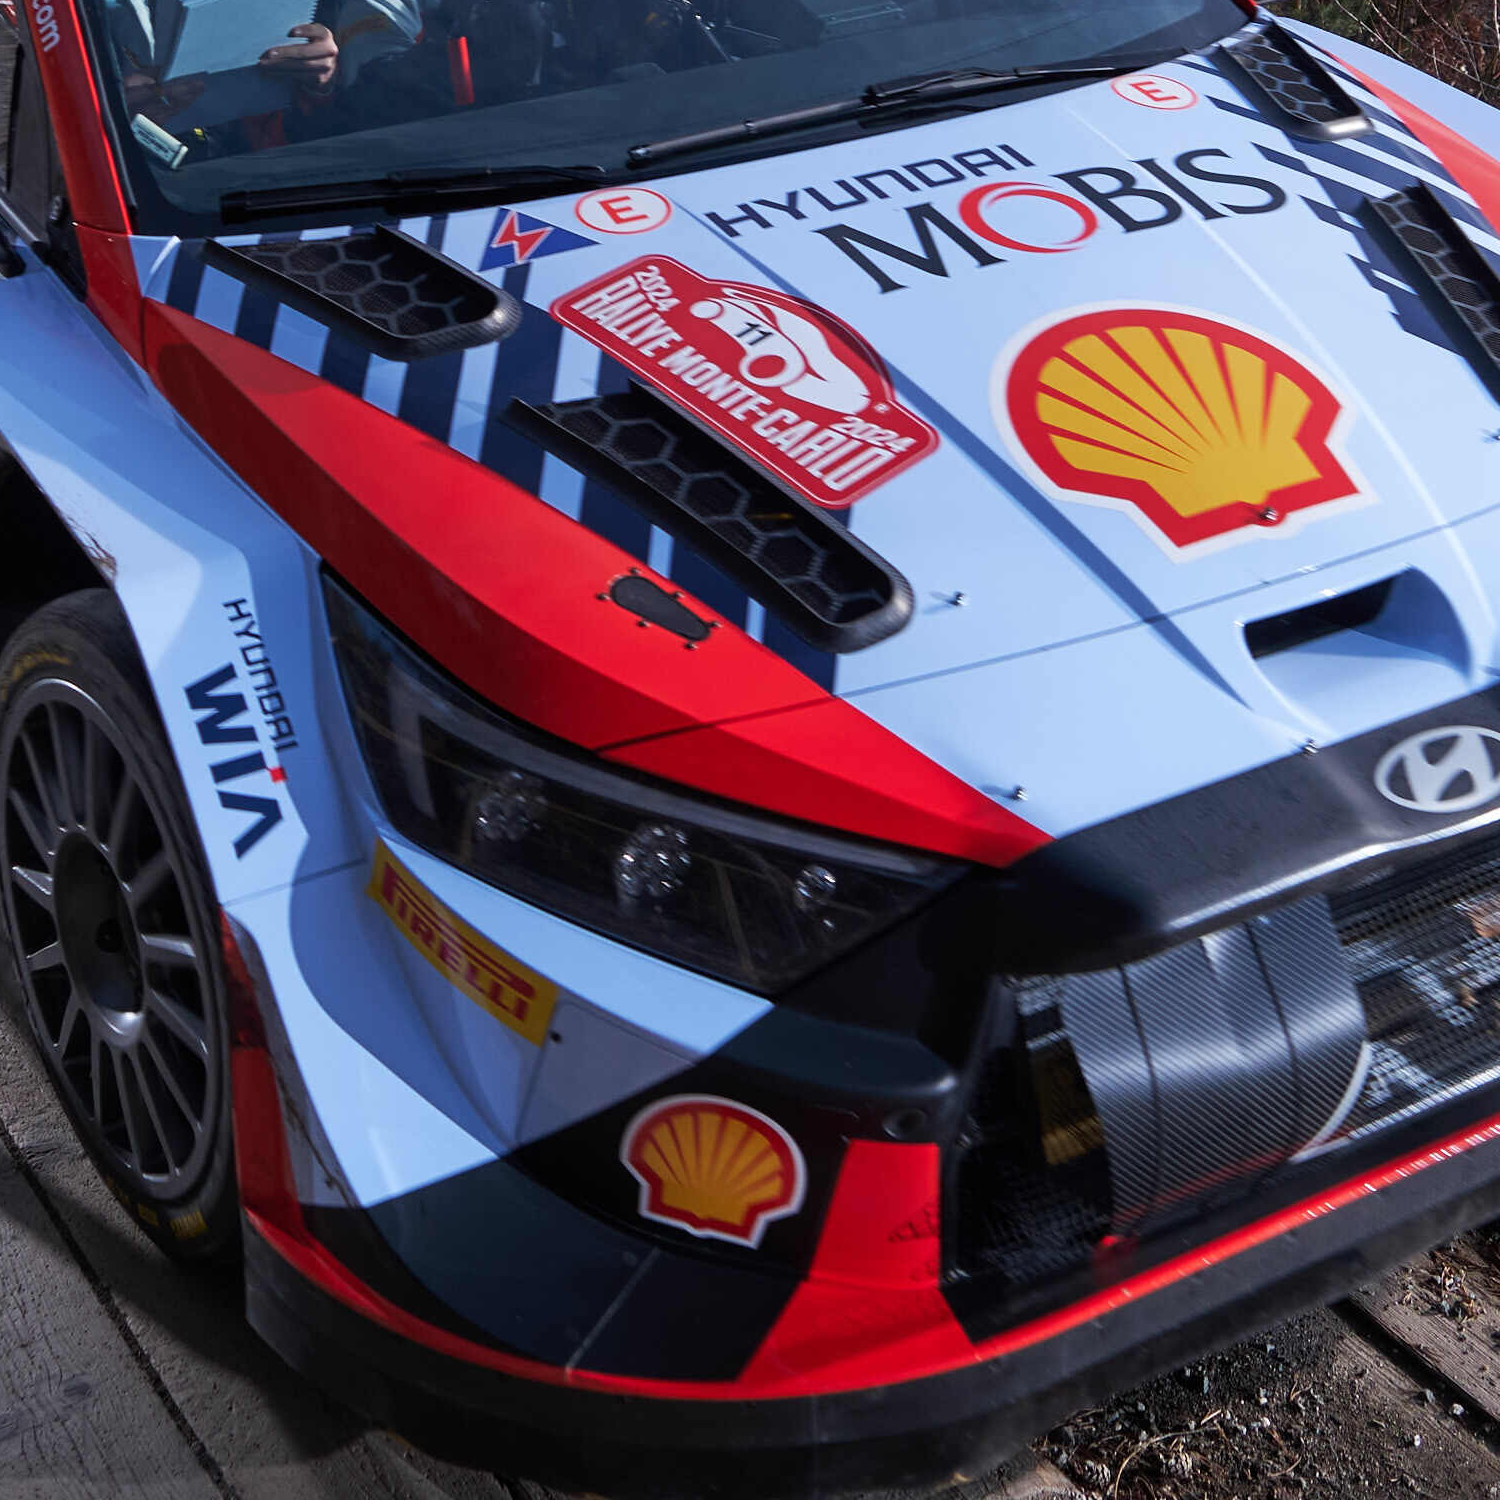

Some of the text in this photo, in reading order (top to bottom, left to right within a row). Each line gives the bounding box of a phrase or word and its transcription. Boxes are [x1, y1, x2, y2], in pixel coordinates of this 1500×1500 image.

[1133, 79, 1174, 104] E
[602, 194, 646, 226] E
[706, 144, 1035, 238] HYUNDAI
[814, 148, 1288, 294] MOBIS
[633, 264, 681, 317] 2024
[743, 319, 776, 346] 11
[570, 276, 900, 495] RALLYE MONTE-CARLO
[838, 412, 916, 454] 2024
[222, 597, 298, 752] HYUNDAI
[380, 860, 536, 1023] PIRELLI
